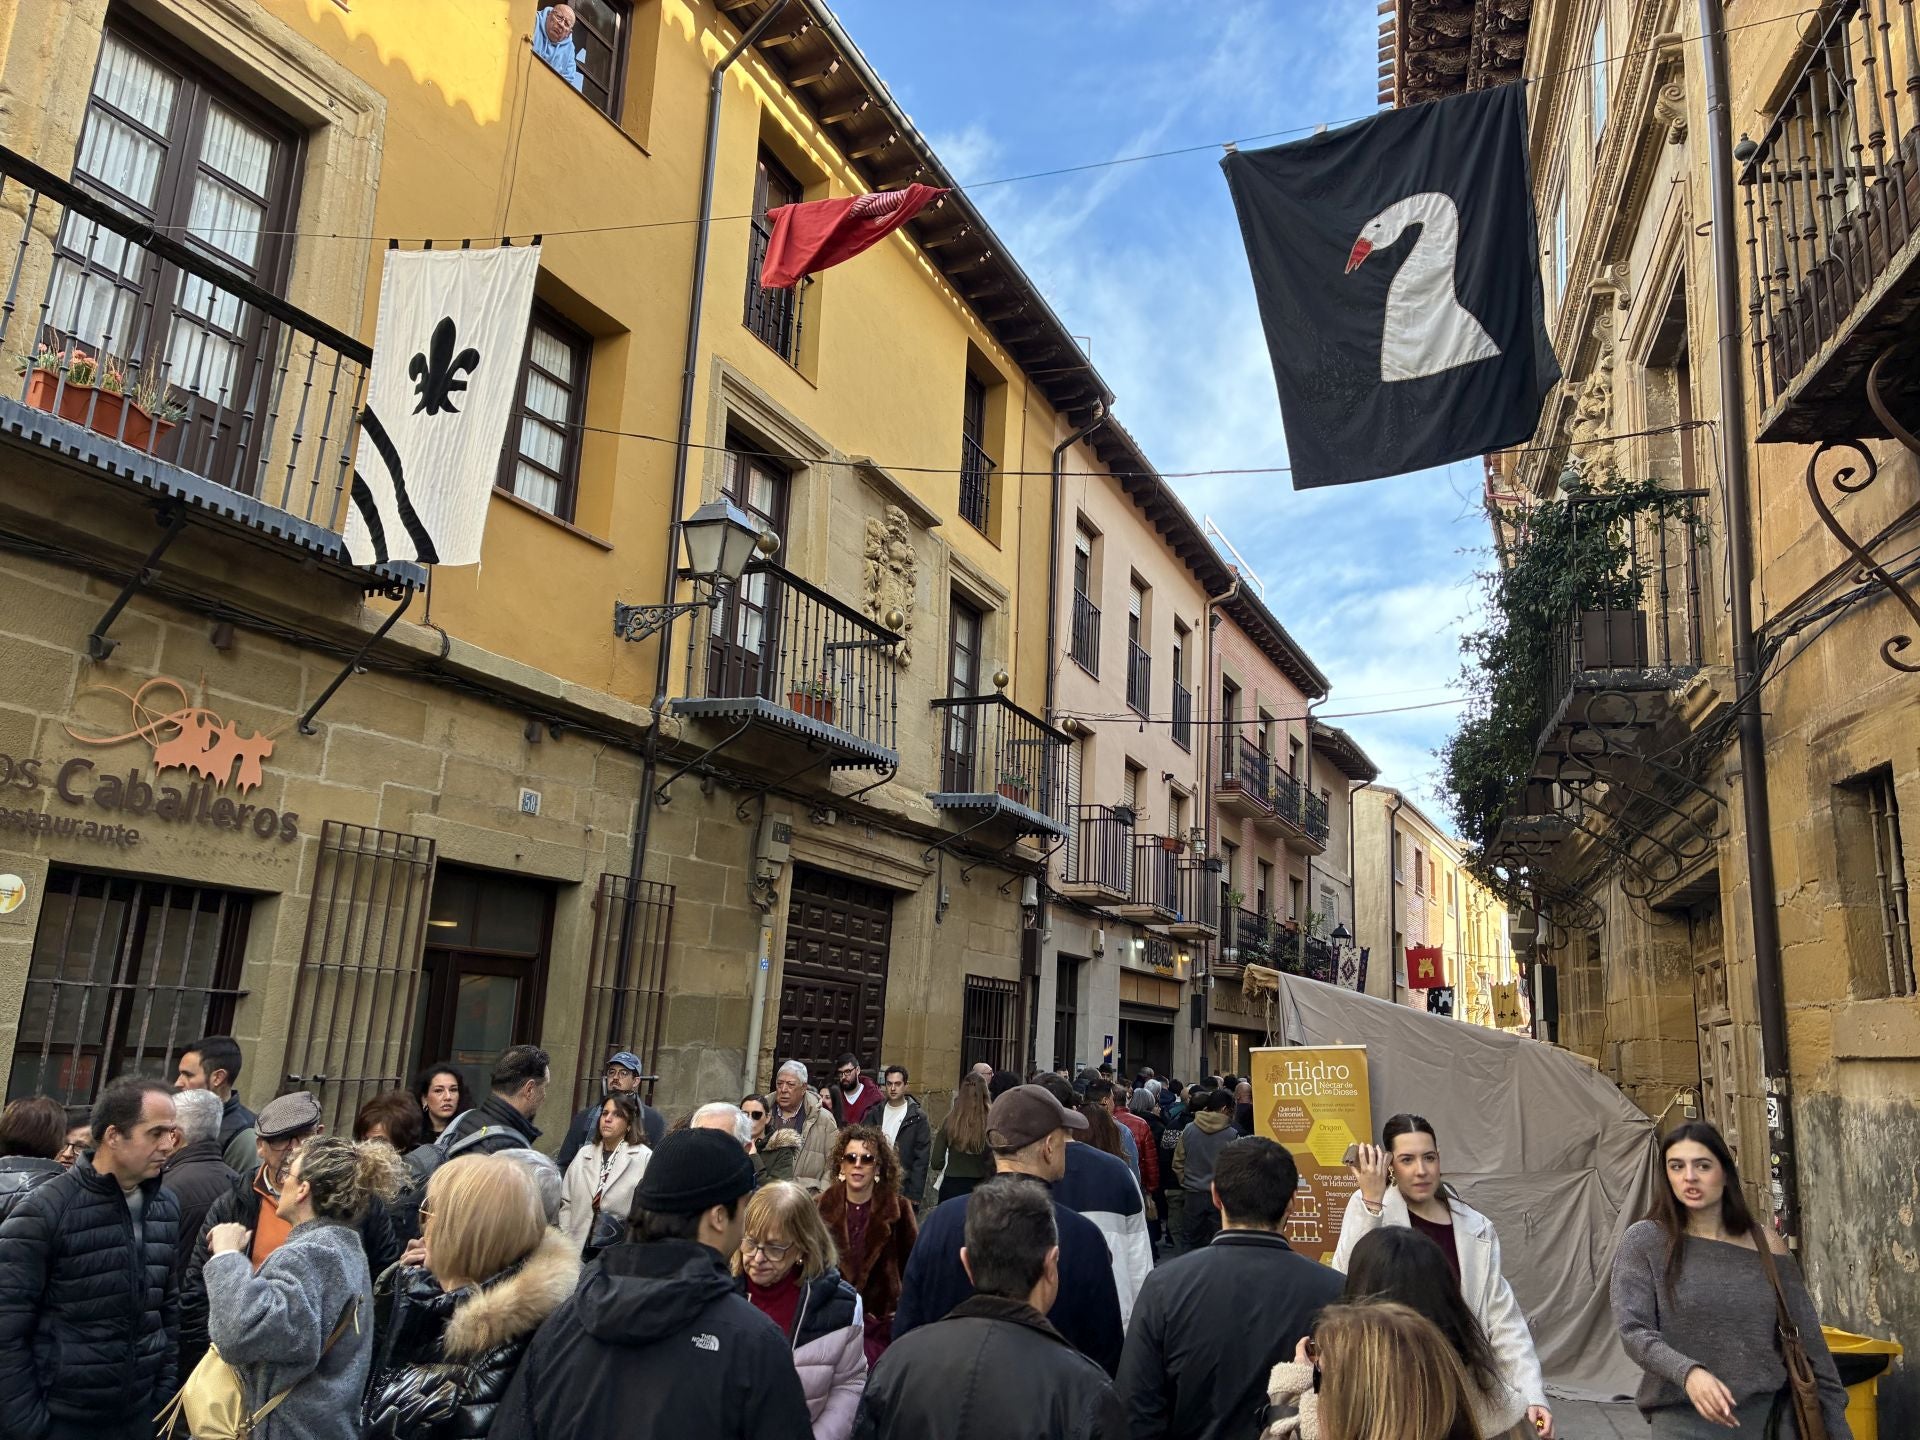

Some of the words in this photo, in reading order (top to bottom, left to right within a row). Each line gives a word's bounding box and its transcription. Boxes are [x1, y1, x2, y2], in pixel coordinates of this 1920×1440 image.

[57, 757, 299, 842] Caballeros
[524, 794, 536, 812] 58
[1285, 1060, 1349, 1080] Hidro
[1273, 1076, 1321, 1097] miel
[1323, 1088, 1333, 1096] los
[1333, 1088, 1359, 1096] Dioses
[1345, 1081, 1354, 1089] de
[1319, 1124, 1342, 1132] Origen
